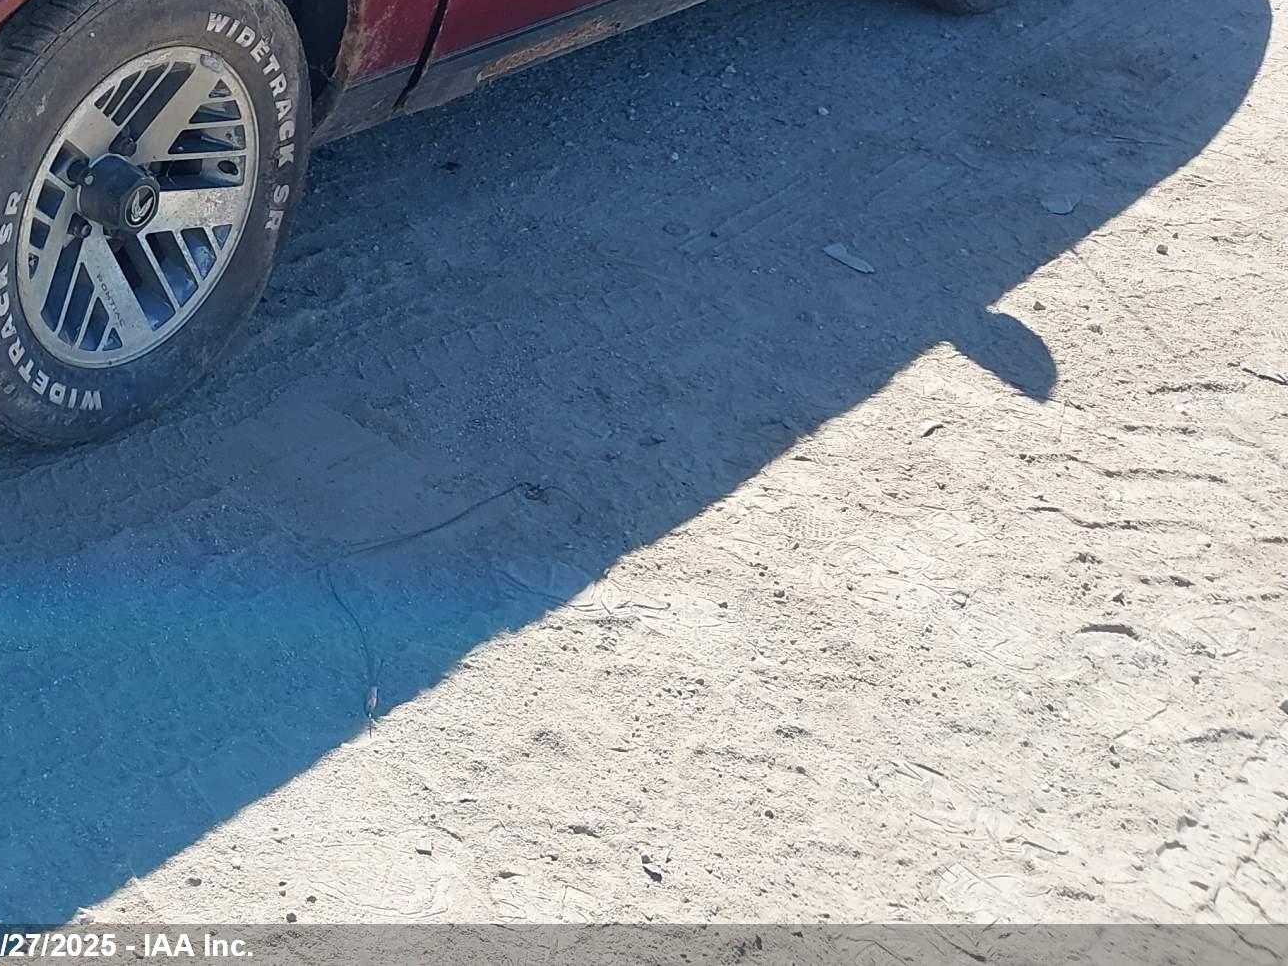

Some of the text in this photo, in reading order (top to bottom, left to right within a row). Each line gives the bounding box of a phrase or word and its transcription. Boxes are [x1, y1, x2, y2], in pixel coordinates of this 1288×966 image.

[205, 11, 296, 232] WIDETRACK SR
[0, 191, 23, 245] SR
[96, 273, 127, 329] PONTIAC
